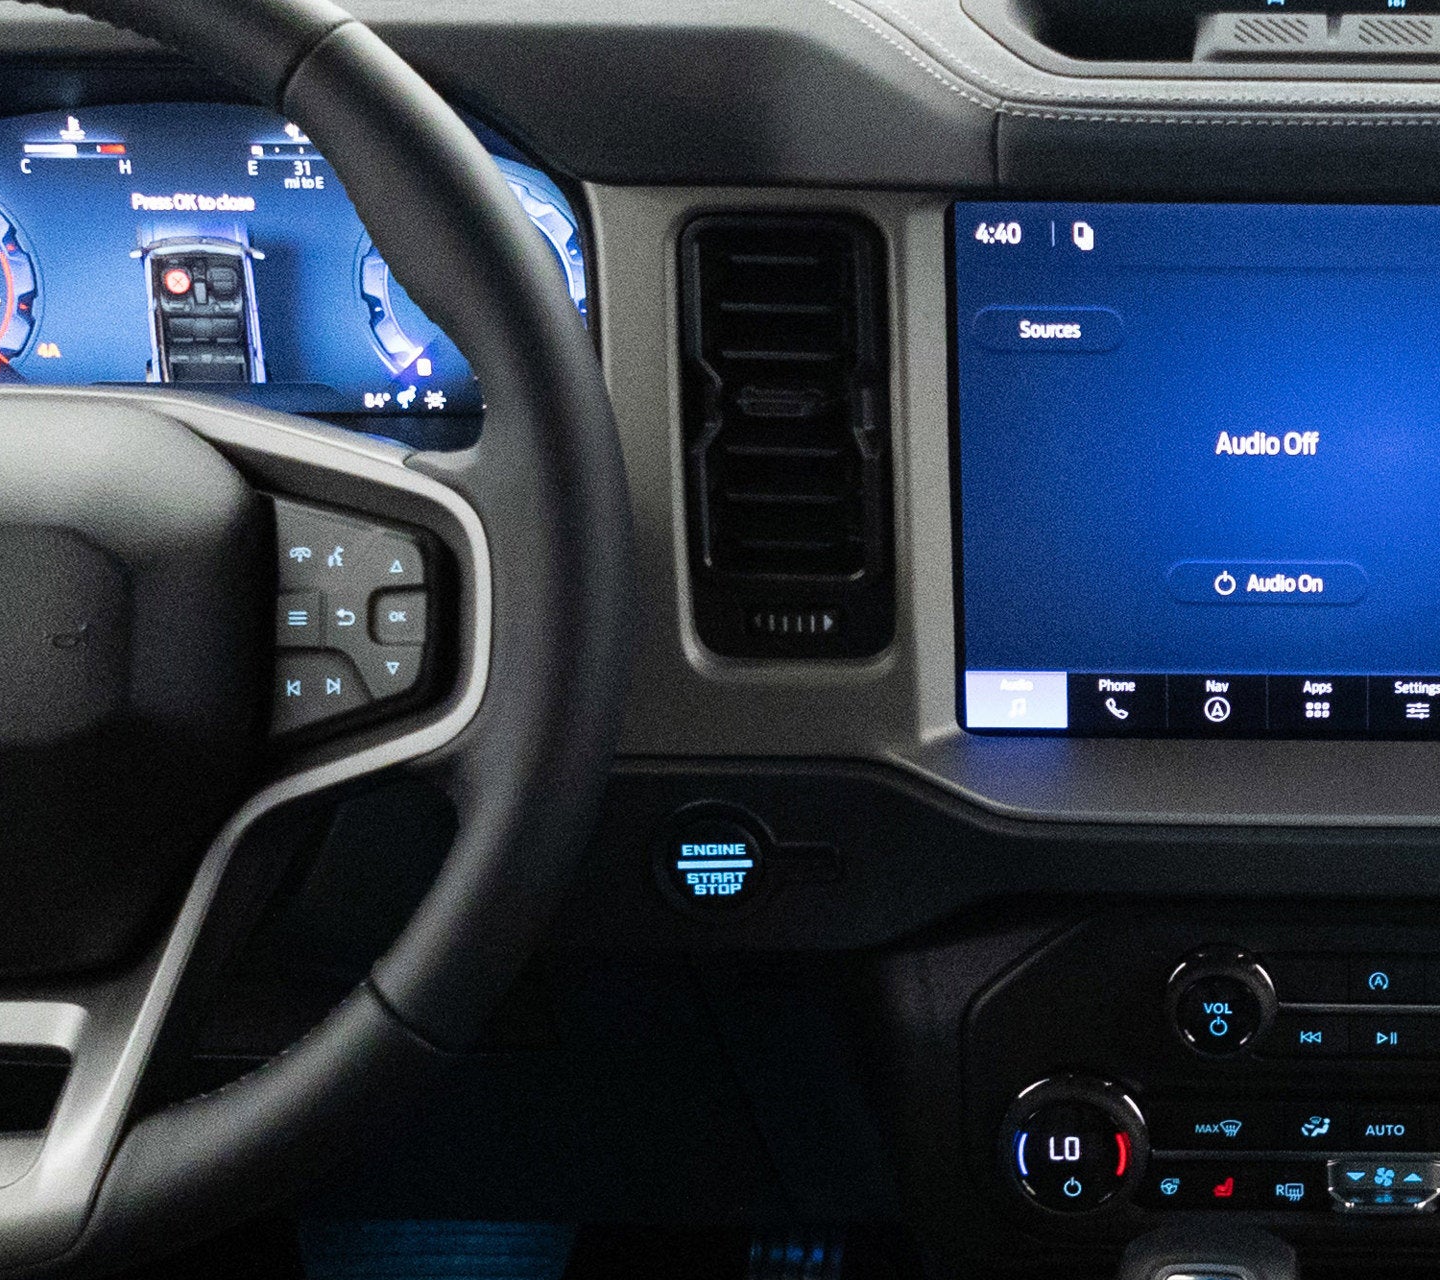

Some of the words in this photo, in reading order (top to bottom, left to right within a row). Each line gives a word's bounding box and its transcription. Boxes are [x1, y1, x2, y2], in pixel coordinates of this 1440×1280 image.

[20, 159, 31, 175] C
[119, 159, 132, 175] H
[247, 160, 258, 176] E
[293, 160, 311, 176] 31
[131, 192, 174, 210] Press
[173, 192, 198, 210] OK
[975, 223, 1022, 246] 4:40
[1019, 321, 1082, 339] Sources
[1216, 431, 1279, 456] Audio
[1283, 431, 1320, 456] Off
[1246, 574, 1295, 594] Audio
[1299, 574, 1324, 594] On
[389, 611, 407, 623] OK
[1098, 678, 1136, 692] Phone
[1206, 680, 1229, 693] Nav
[1303, 680, 1332, 697] Apps
[681, 844, 747, 856] ENGINE
[686, 871, 747, 884] START
[694, 883, 742, 895] STOP
[1204, 1002, 1233, 1014] VOL
[1194, 1123, 1220, 1133] MAX
[1365, 1124, 1405, 1136] AUTO
[1049, 1136, 1080, 1161] LO
